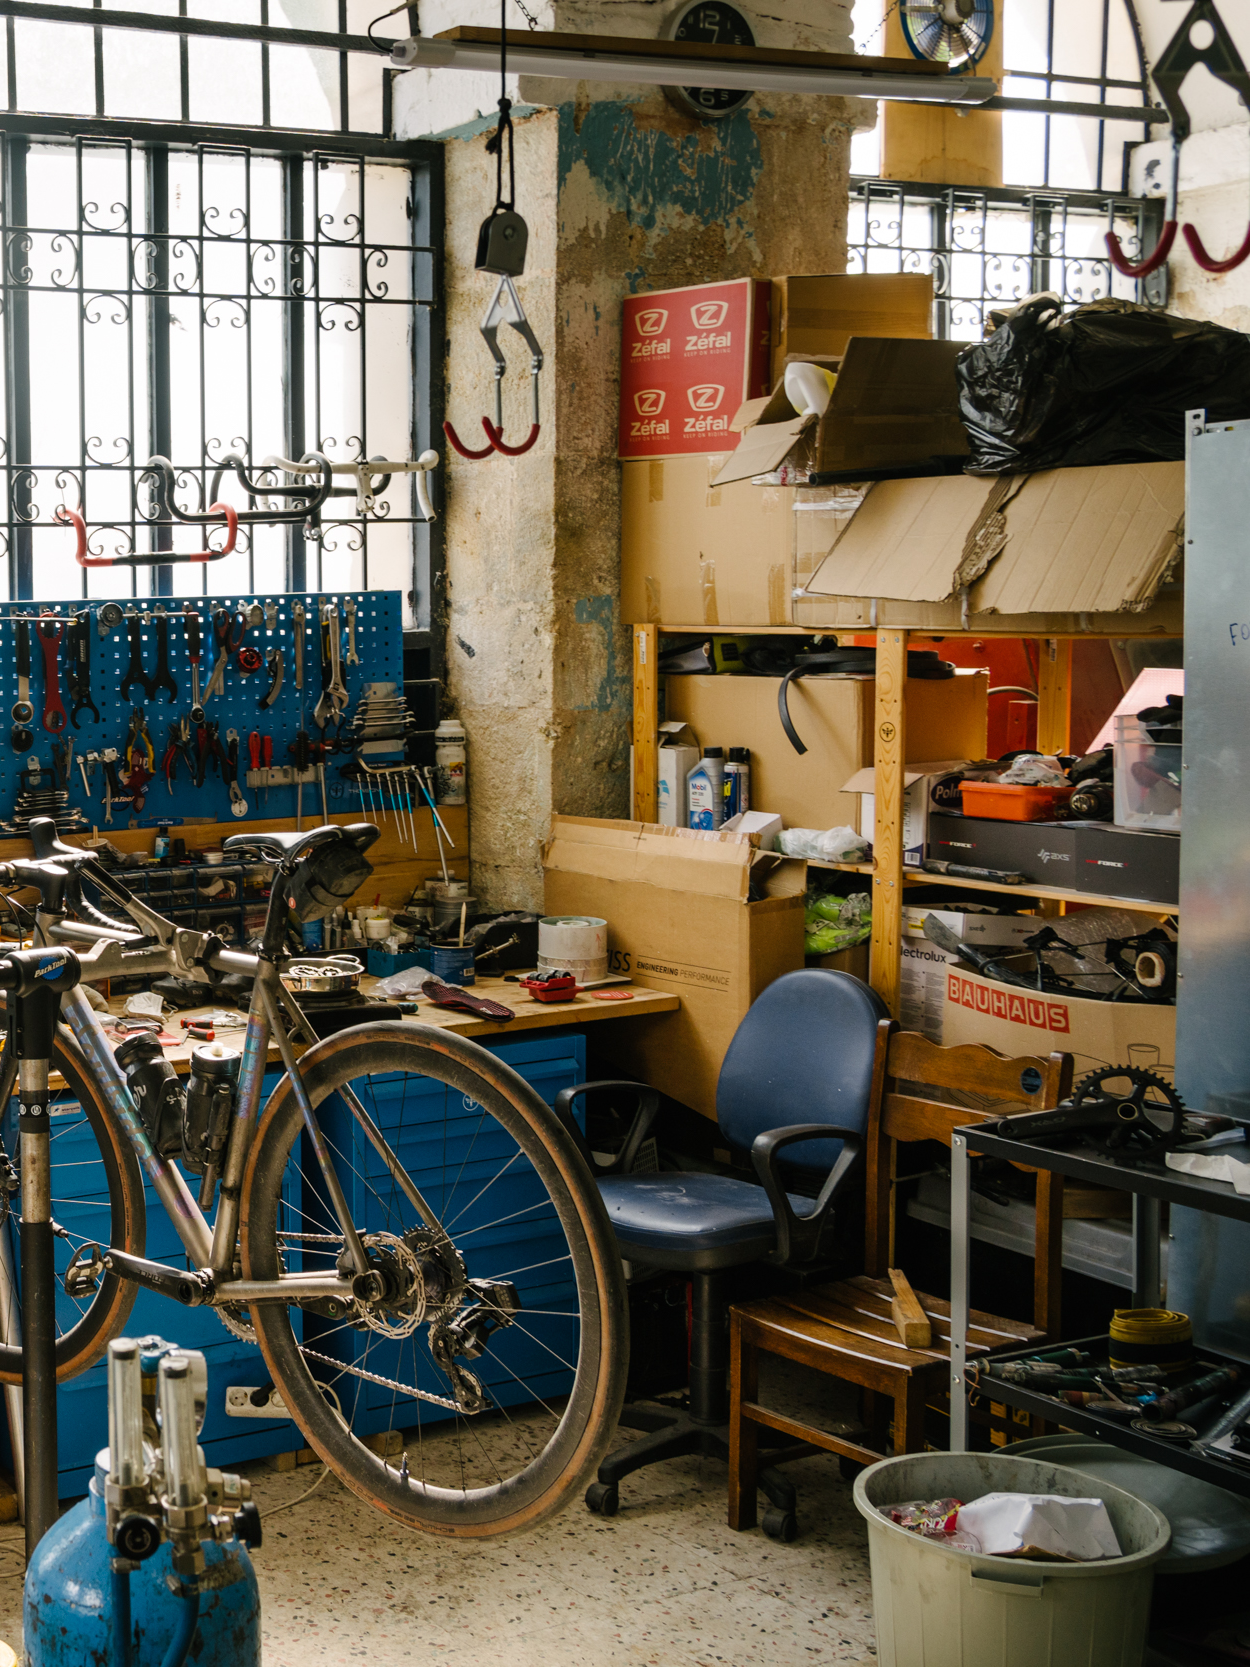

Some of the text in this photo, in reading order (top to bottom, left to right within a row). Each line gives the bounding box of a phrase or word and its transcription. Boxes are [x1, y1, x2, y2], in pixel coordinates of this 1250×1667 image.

[700, 10, 719, 29] 12
[700, 88, 715, 106] 6
[631, 338, 671, 357] Zéfal
[684, 331, 731, 351] Zéfal
[630, 419, 670, 436] Zéfal
[684, 415, 728, 433] Zéfal
[691, 783, 707, 791] Mobil
[101, 796, 135, 804] PrkTool
[901, 945, 946, 964] lectrolux
[34, 957, 67, 979] ParkTool
[607, 949, 730, 986] ISS ENGINEERING PERFORMANCE
[949, 977, 1067, 1030] BAUHAUS
